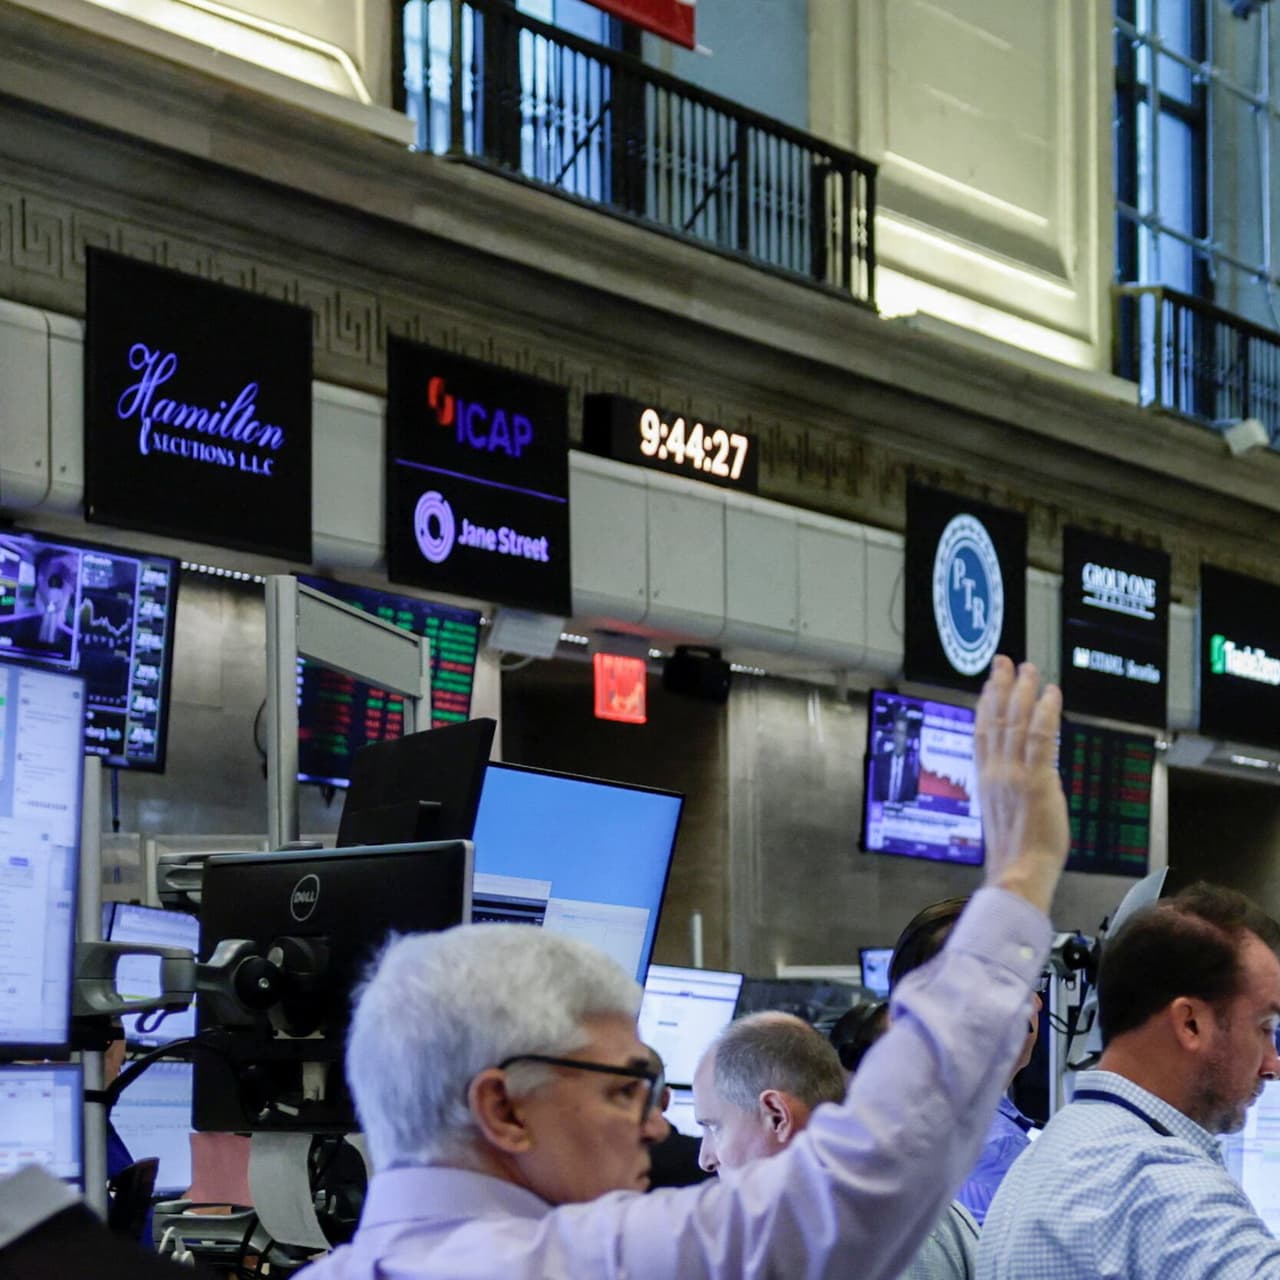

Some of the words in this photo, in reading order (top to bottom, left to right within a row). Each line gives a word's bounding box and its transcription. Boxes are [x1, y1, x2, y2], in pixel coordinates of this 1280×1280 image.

[117, 342, 285, 450] Hamilton
[455, 399, 534, 459] ICAP
[640, 408, 749, 480] 9:44:27
[457, 517, 497, 552] Jane
[497, 526, 550, 563] Street
